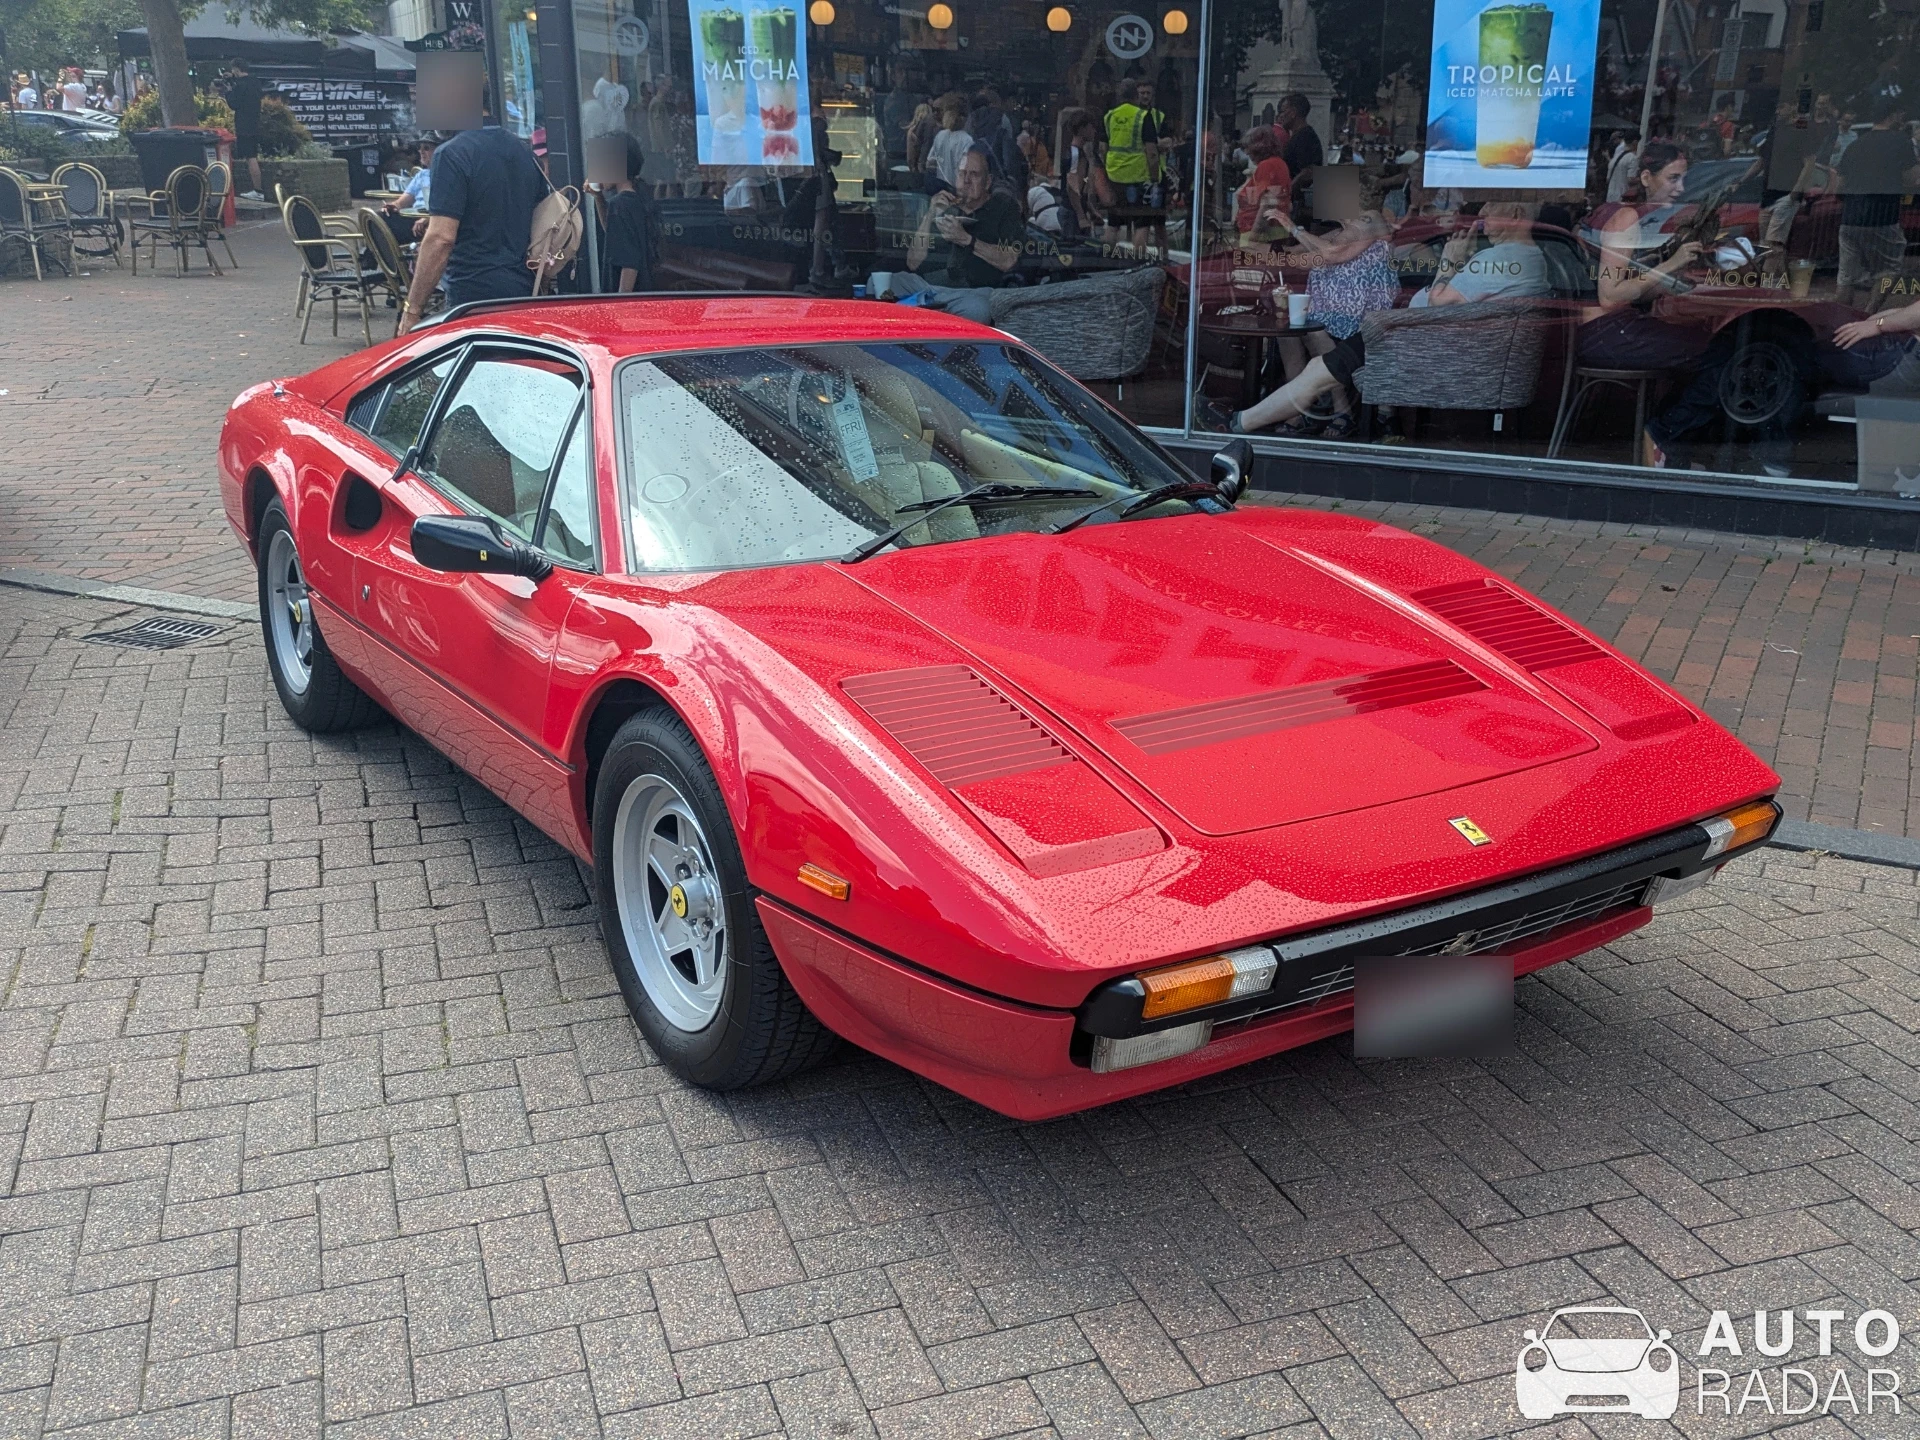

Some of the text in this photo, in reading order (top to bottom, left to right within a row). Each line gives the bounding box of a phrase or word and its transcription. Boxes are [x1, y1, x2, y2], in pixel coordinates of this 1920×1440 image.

[451, 2, 472, 19] W
[737, 46, 760, 55] ICED
[702, 58, 800, 81] MATCHA
[1447, 64, 1577, 84] TROPICAL
[278, 82, 363, 91] PRIME
[1447, 86, 1575, 98] ICED MATCHA LATTE
[298, 90, 376, 101] SHINE
[305, 104, 324, 112] YOUR
[892, 234, 936, 249] LATTE
[997, 238, 1060, 256] MOCHA
[1102, 244, 1164, 262] PANINI
[1232, 250, 1325, 268] ESPRESSO
[1387, 257, 1522, 277] CAPPUCCINO
[1589, 265, 1649, 282] LATTE
[1704, 268, 1791, 290] MOCHA
